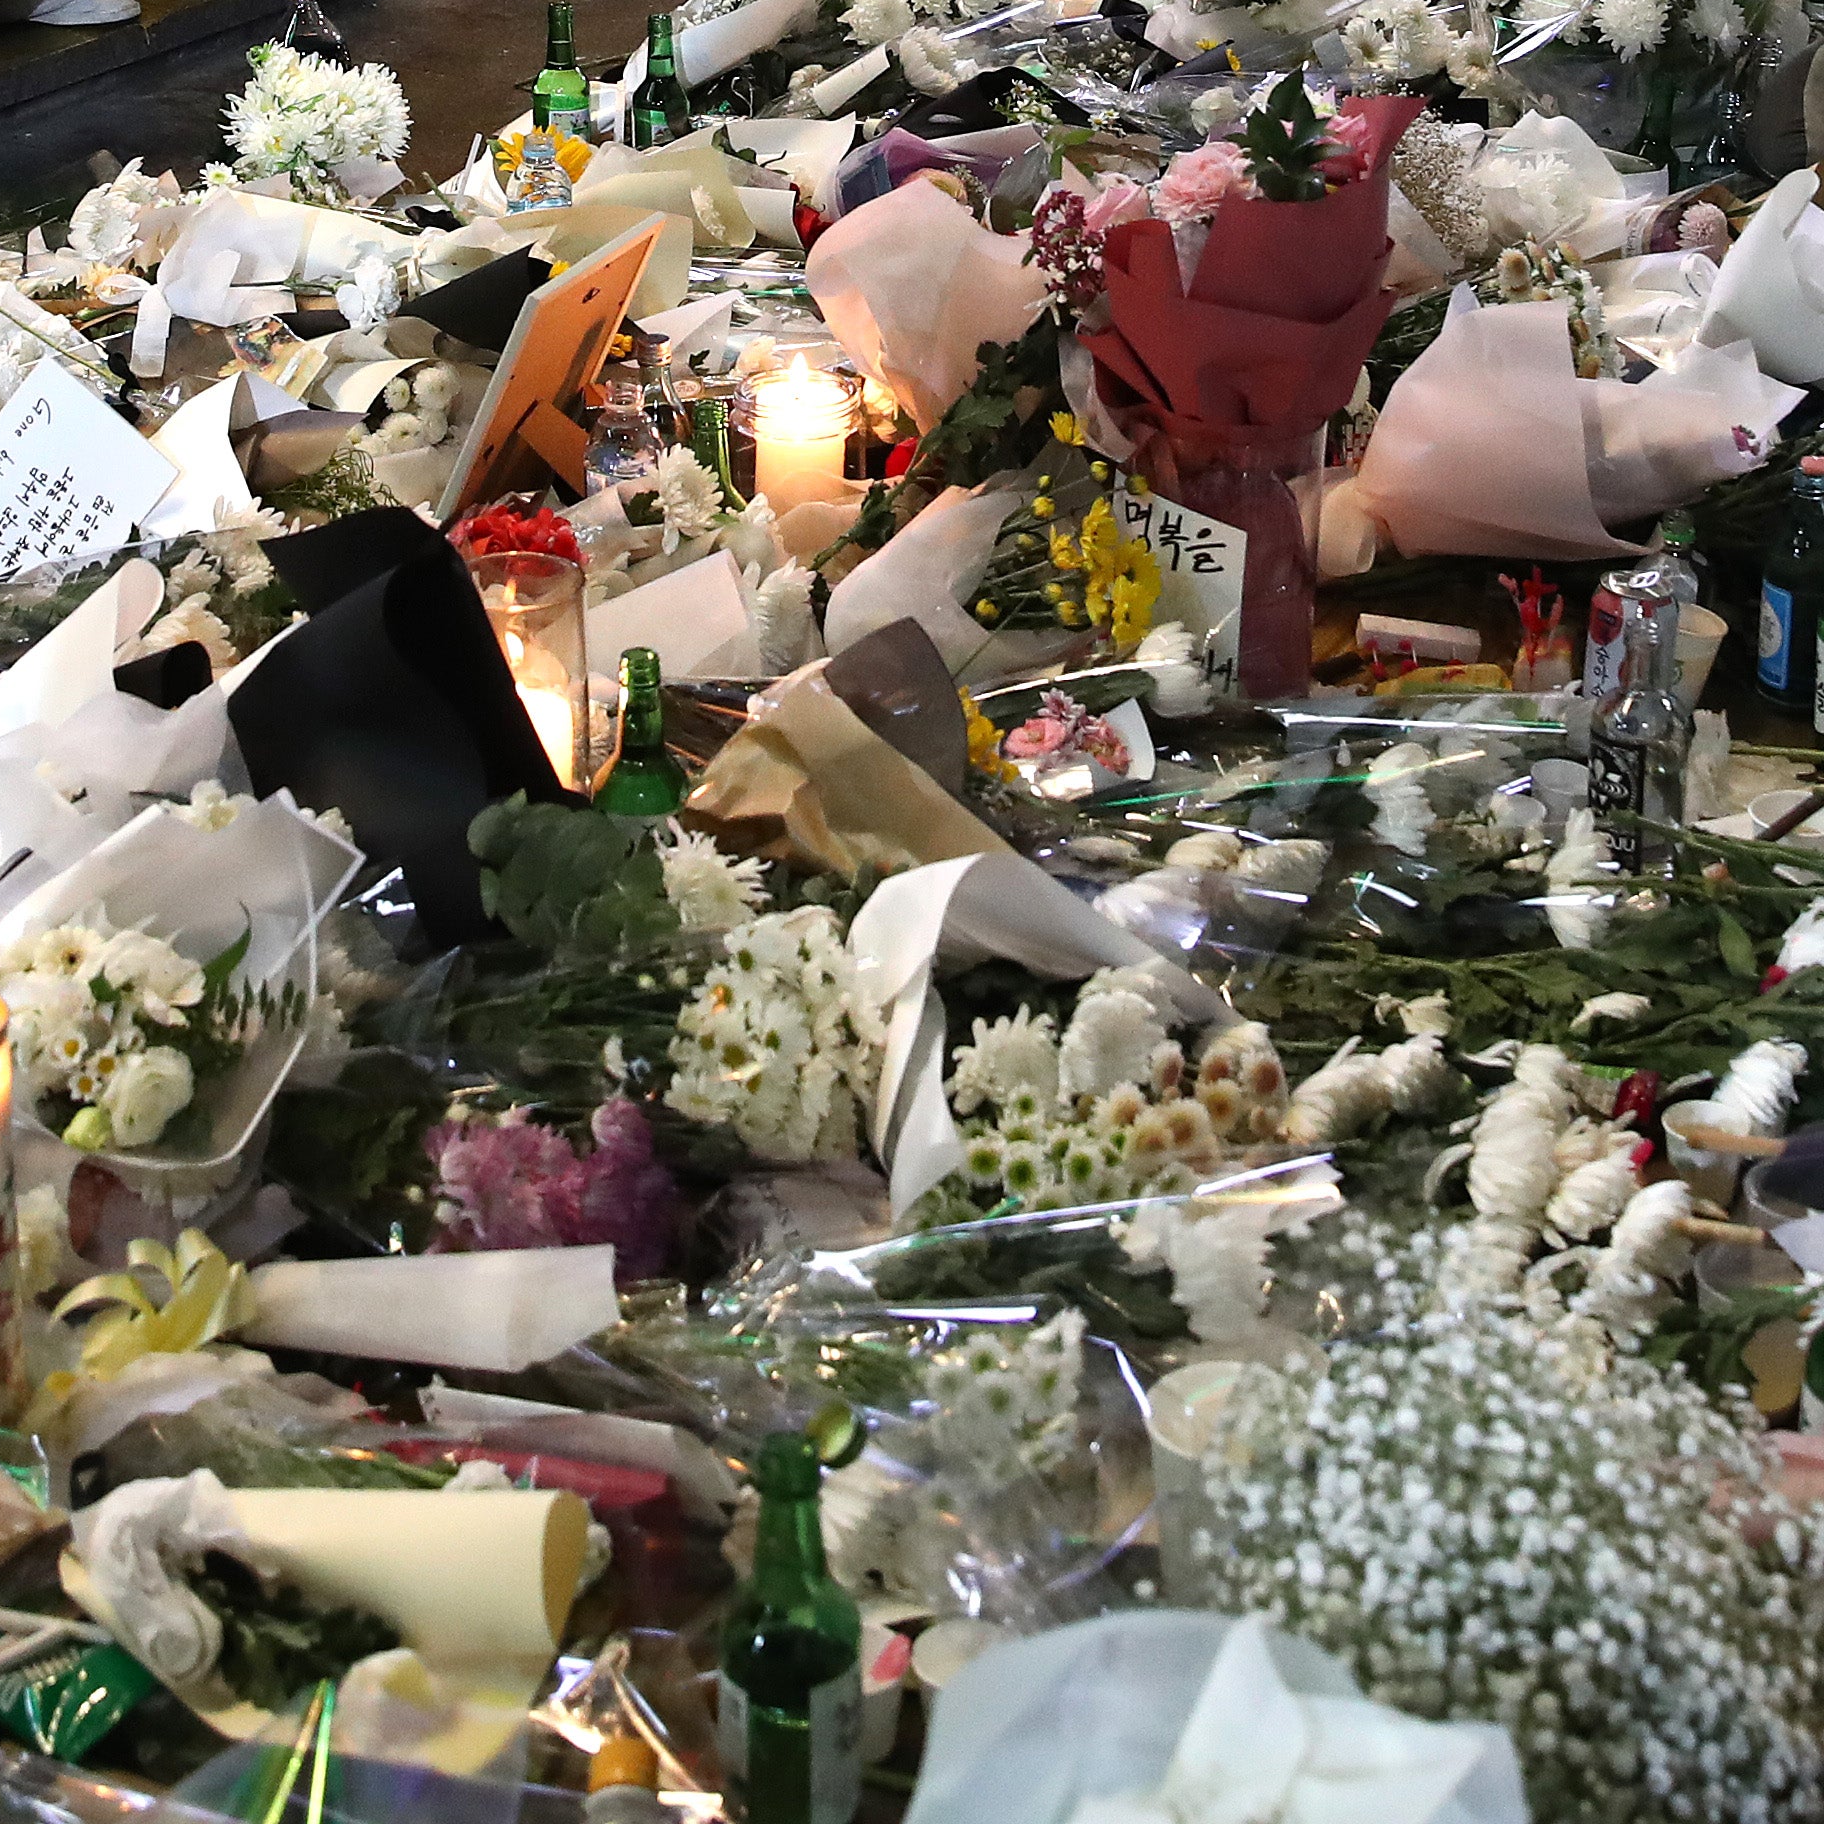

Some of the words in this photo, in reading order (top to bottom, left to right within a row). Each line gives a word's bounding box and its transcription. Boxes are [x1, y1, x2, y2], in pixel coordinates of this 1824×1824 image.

[14, 397, 51, 438] Gone
[16, 467, 49, 508] 멈추지
[1125, 500, 1226, 573] 명복을
